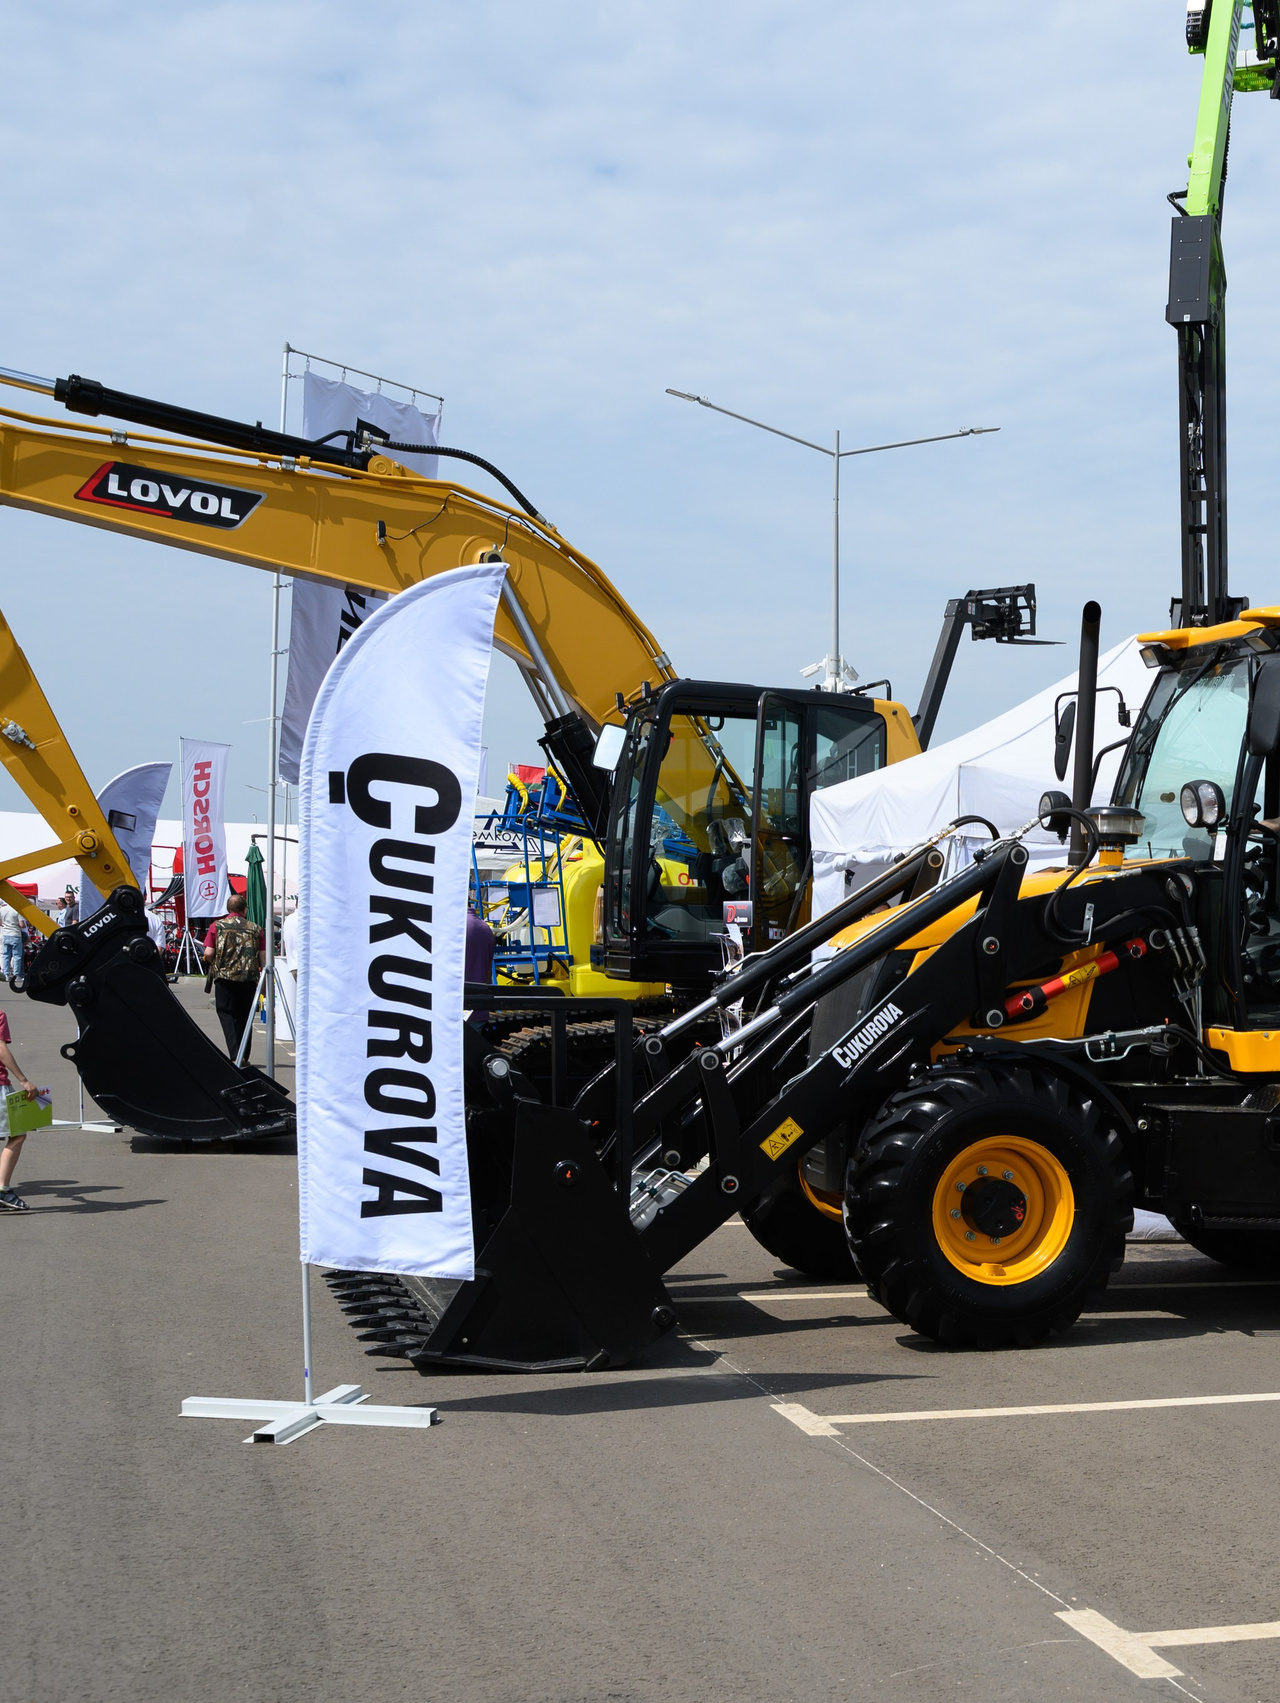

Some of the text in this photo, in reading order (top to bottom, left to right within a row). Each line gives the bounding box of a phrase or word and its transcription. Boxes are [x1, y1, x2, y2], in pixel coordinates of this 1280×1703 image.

[107, 473, 240, 520] LOVOL
[83, 912, 117, 938] LOVOL
[328, 752, 463, 1219] ÇUKUROVA
